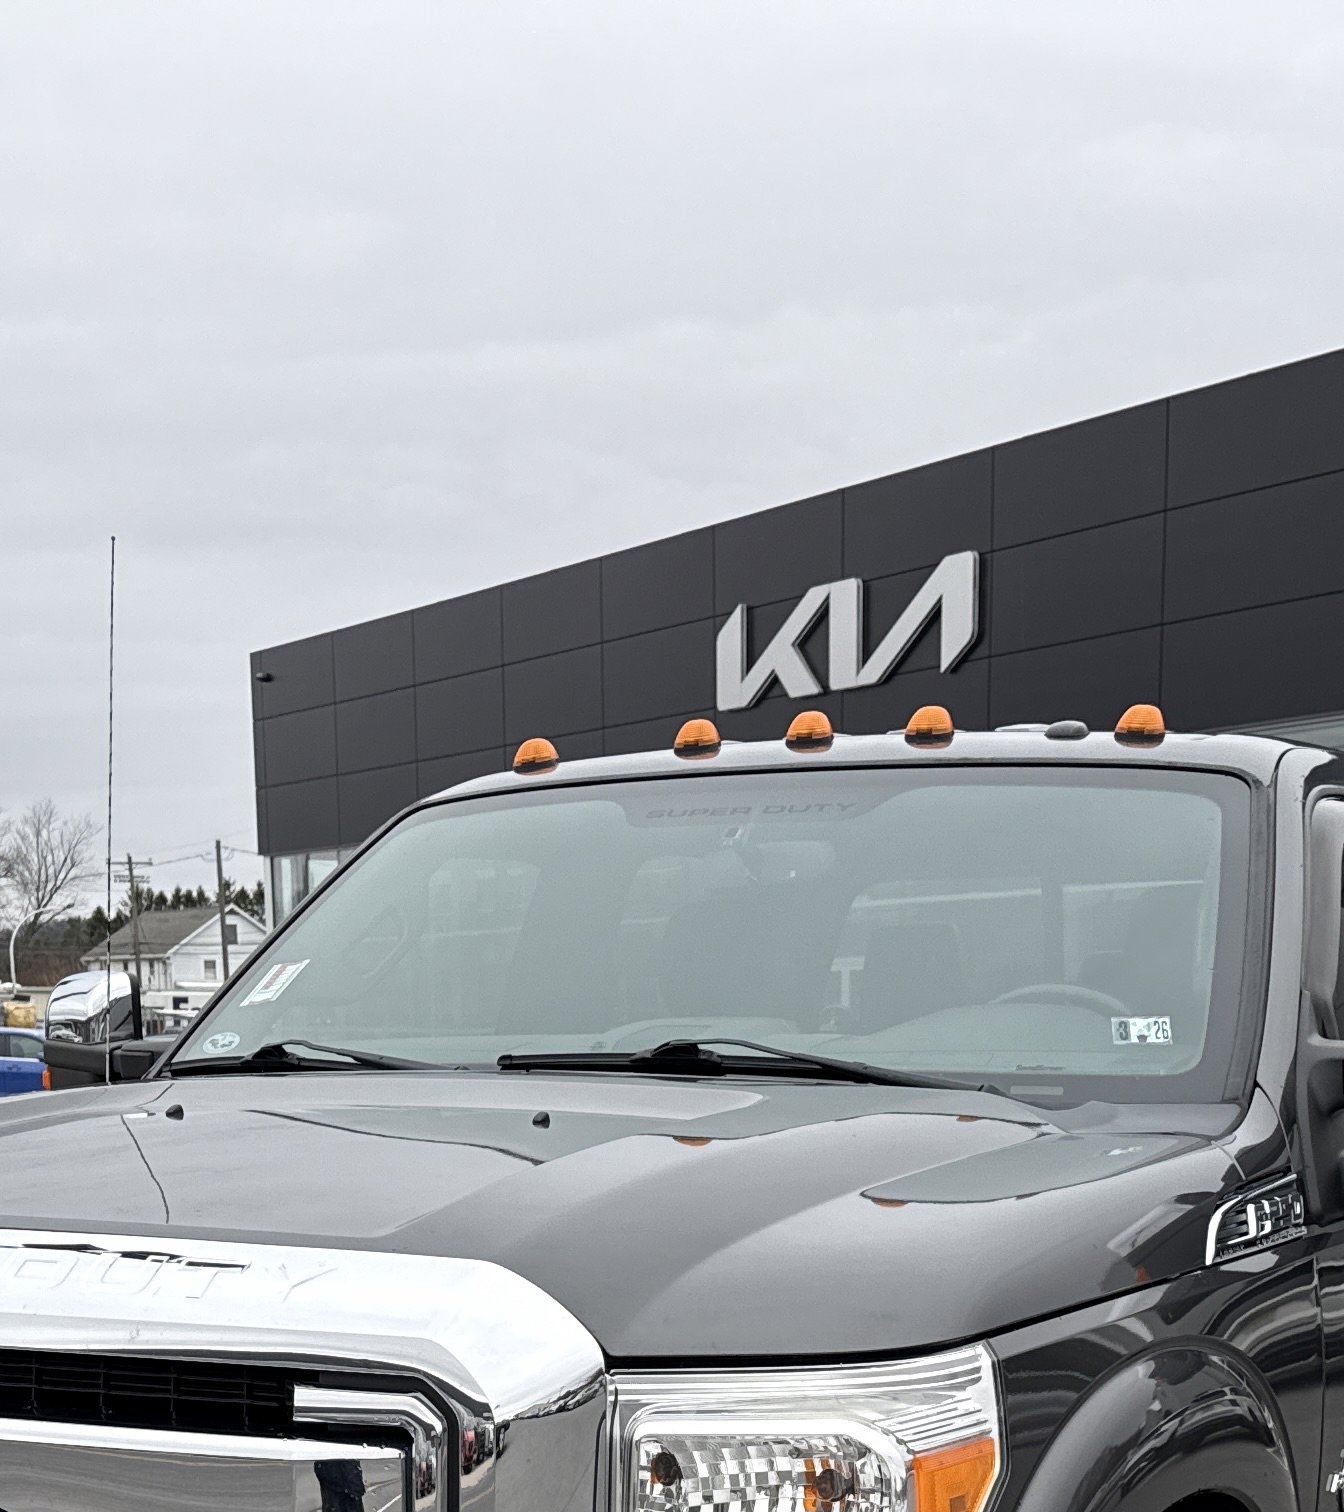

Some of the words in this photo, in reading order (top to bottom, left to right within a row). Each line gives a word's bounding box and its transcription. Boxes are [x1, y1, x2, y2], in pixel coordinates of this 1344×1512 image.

[716, 550, 980, 711] KIA
[644, 805, 753, 820] SUPER
[761, 802, 858, 815] DUTY
[1117, 1020, 1129, 1041] 3
[1153, 1020, 1170, 1040] 26
[12, 1243, 340, 1304] DUTY
